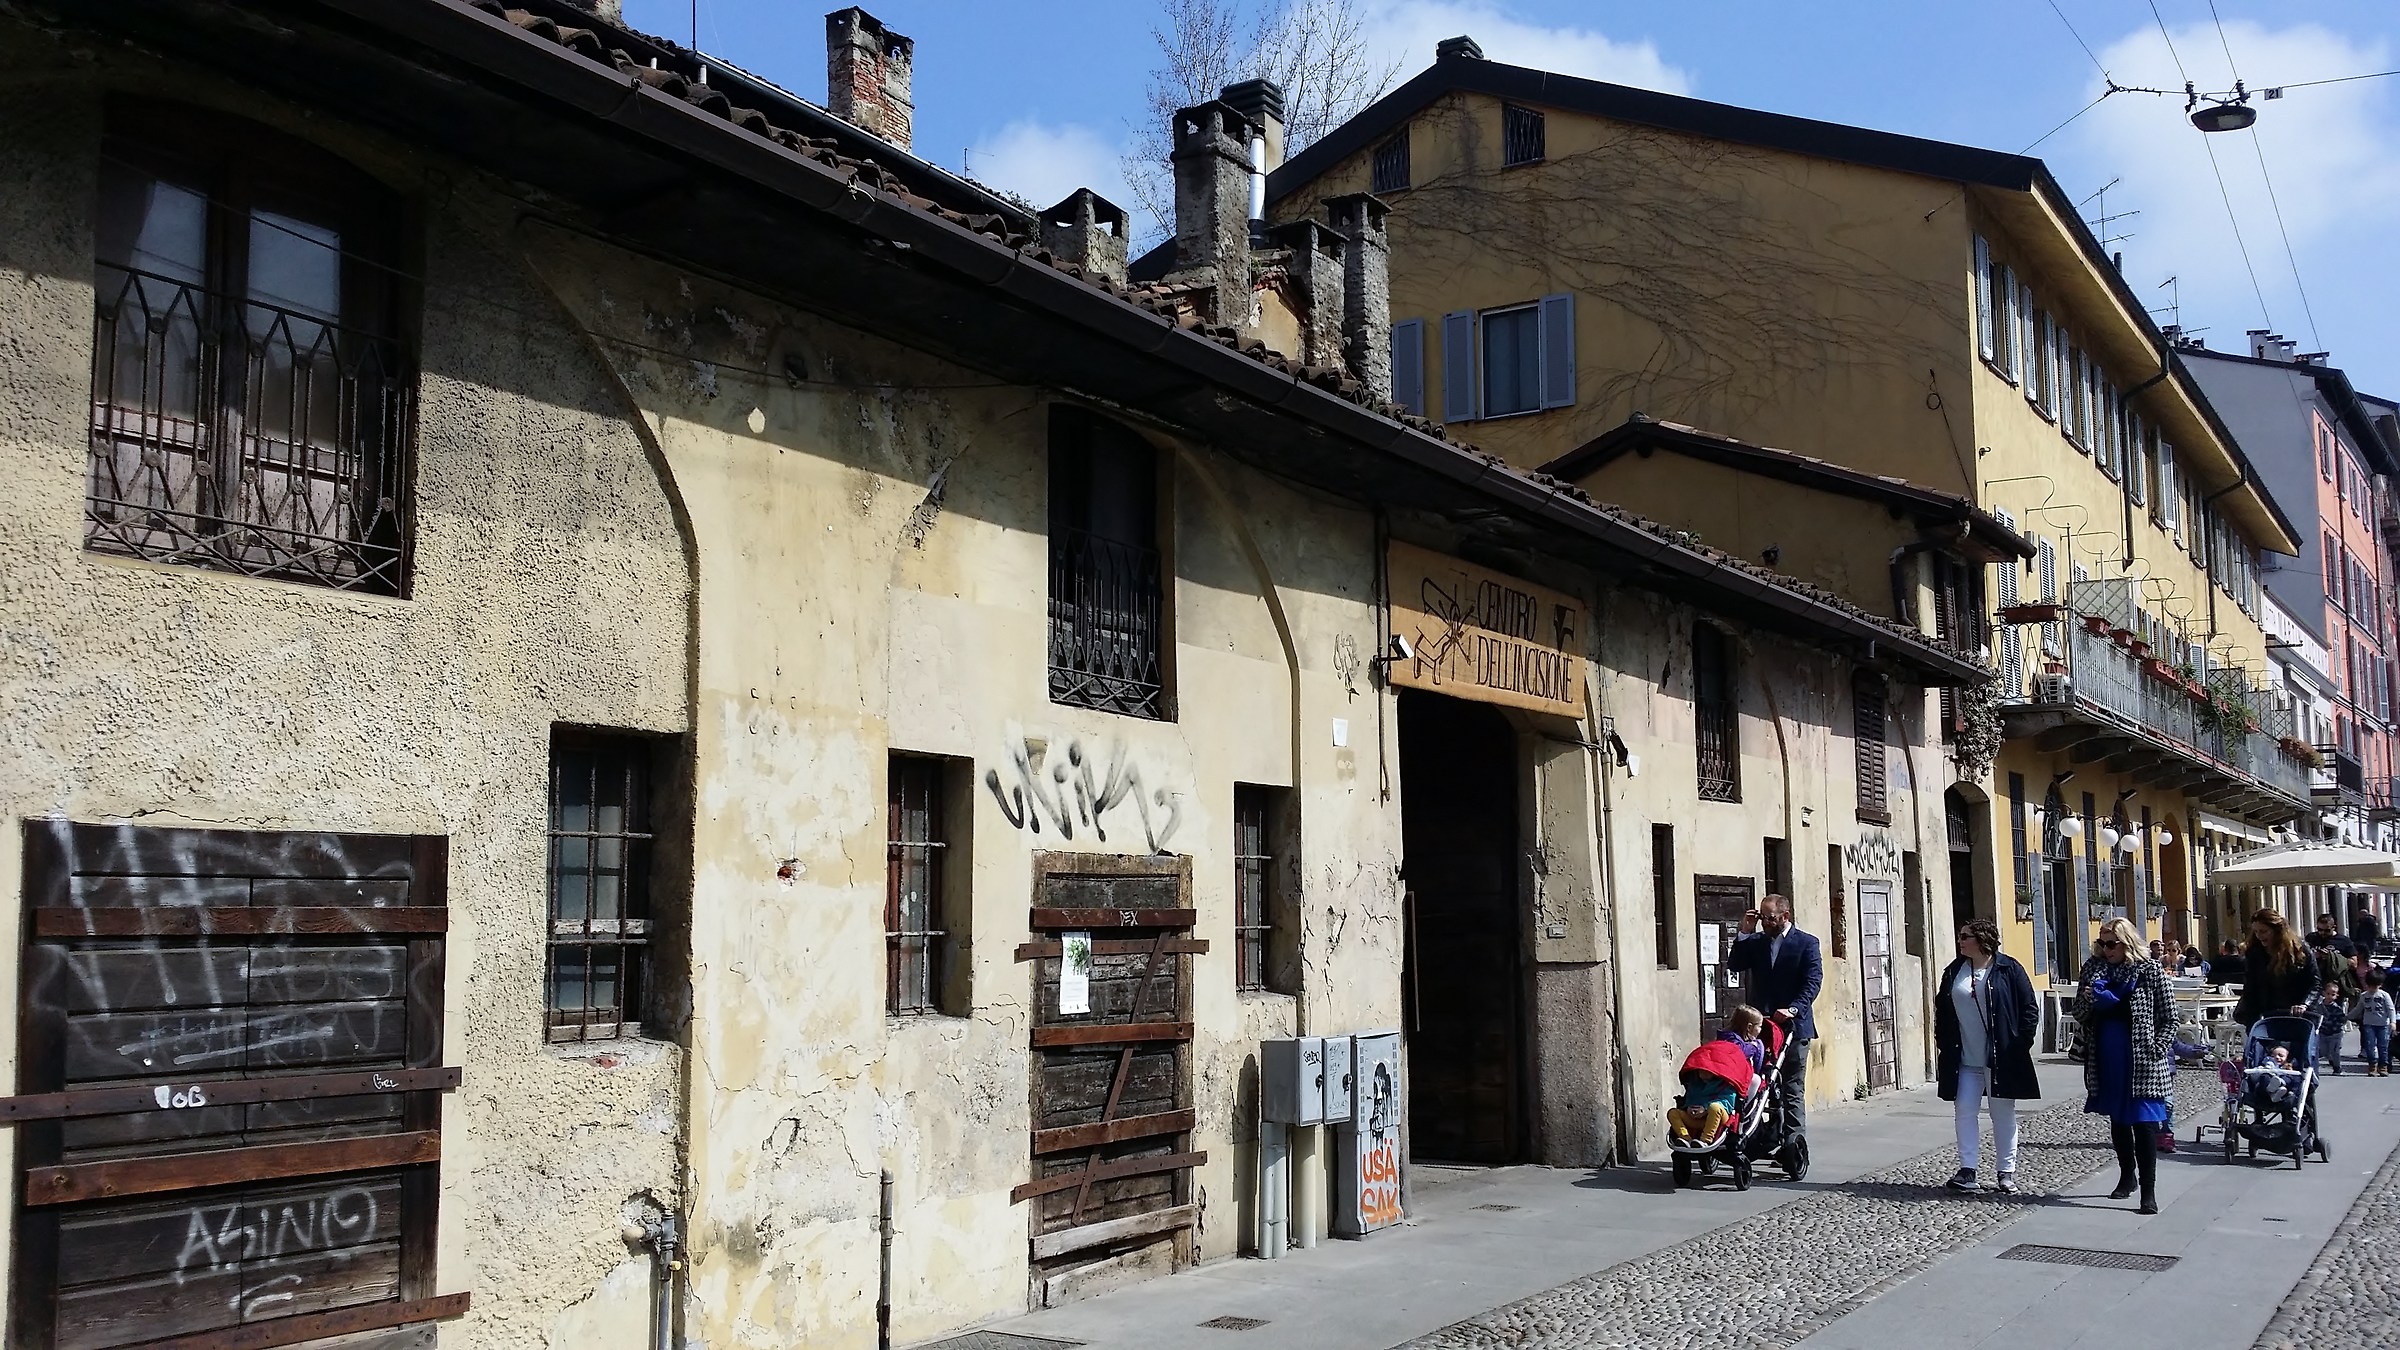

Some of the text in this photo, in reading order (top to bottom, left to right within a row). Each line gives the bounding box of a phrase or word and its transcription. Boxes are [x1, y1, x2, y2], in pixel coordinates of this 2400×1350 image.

[2268, 89, 2279, 99] 21
[1477, 579, 1537, 641] CENTRO
[1475, 634, 1573, 704] DELL'INCISIONE
